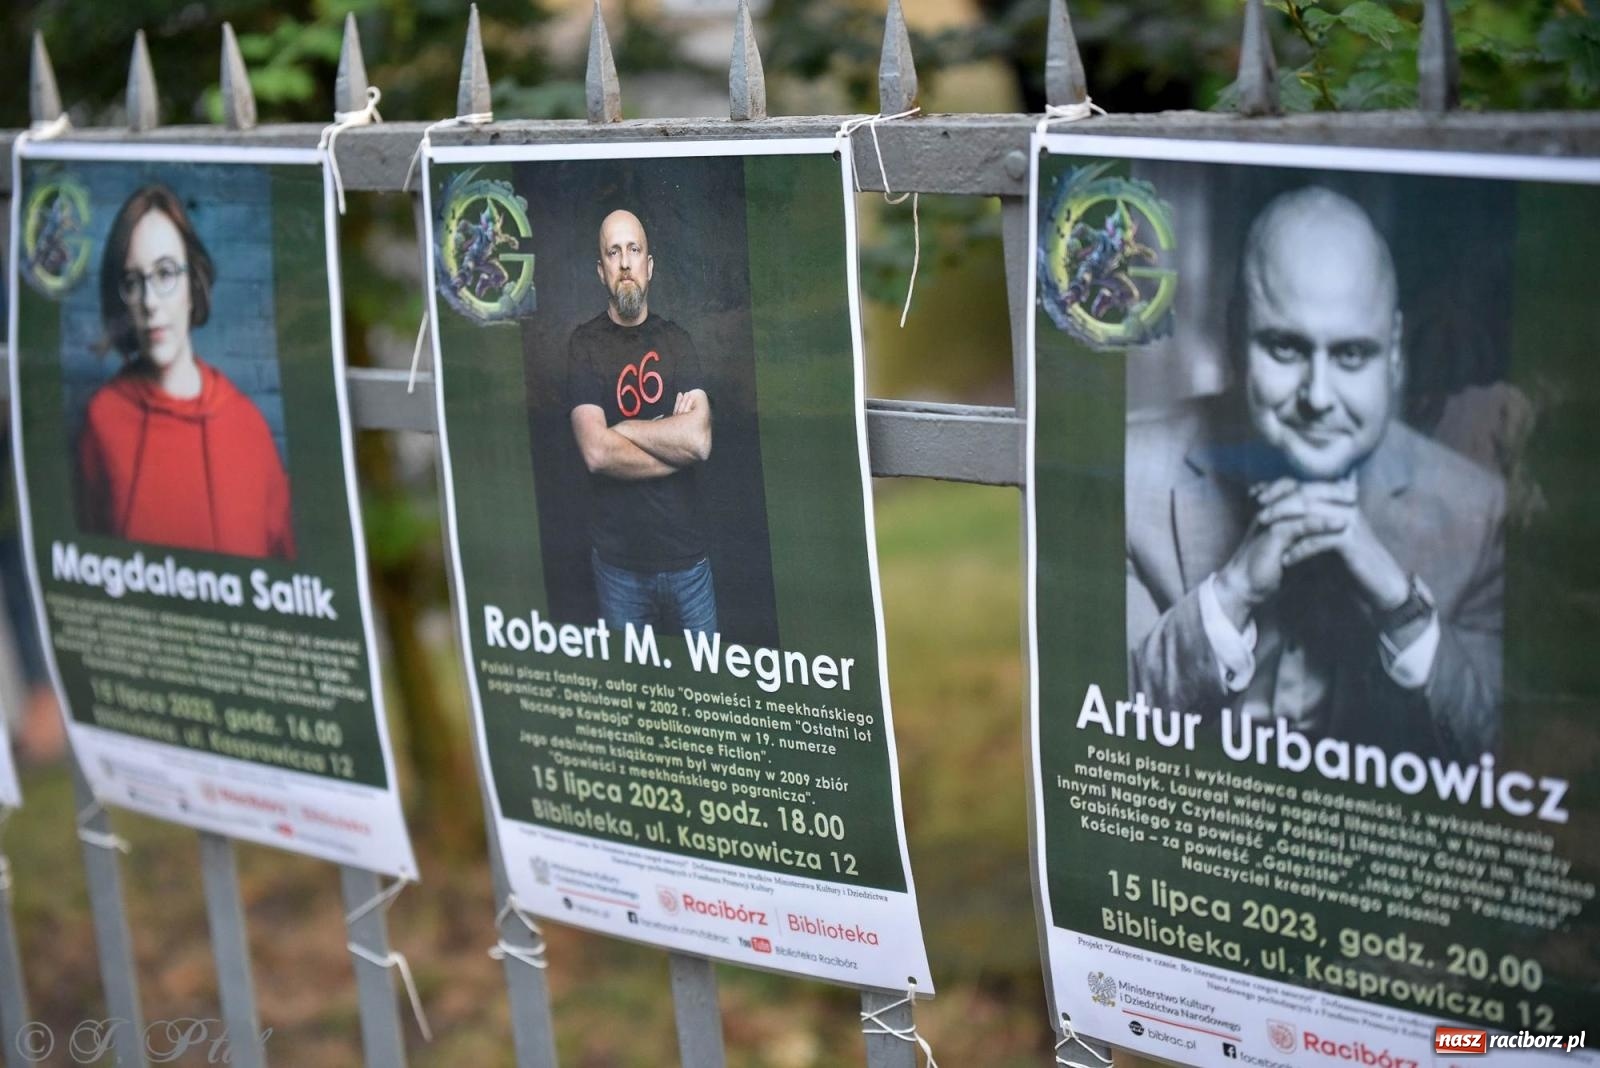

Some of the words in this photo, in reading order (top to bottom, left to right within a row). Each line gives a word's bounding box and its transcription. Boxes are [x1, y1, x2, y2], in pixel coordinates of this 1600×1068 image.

[616, 351, 663, 418] 66
[51, 540, 244, 606] Magdalena
[250, 568, 338, 620] Salik
[484, 605, 610, 660] Robert
[624, 621, 672, 669] M.
[684, 628, 854, 692] Wegner
[481, 660, 513, 675] Polski
[517, 666, 551, 682] pisarz
[605, 679, 637, 693] autor
[641, 684, 674, 698] cyklu
[679, 687, 751, 709] "Opowieści
[755, 700, 762, 709] z
[766, 700, 874, 726] meekhańskiego
[637, 701, 646, 711] w
[650, 701, 679, 716] 2002
[682, 709, 691, 717] r.
[695, 709, 792, 731] opowiadaniem
[796, 719, 850, 739] "Ostatni
[853, 728, 872, 742] lot
[520, 698, 574, 719] Nocnego
[576, 707, 632, 726] Kowboja"
[638, 717, 737, 742] opublikowanym
[741, 734, 751, 743] w
[756, 732, 774, 747] 19.
[779, 738, 837, 755] numerze
[575, 725, 654, 746] miesięcznika
[1076, 683, 1202, 750] Artur
[1221, 707, 1570, 824] Urbanowicz
[329, 754, 355, 778] 12
[520, 730, 548, 748] Jego
[550, 736, 606, 755] debiutem
[609, 744, 683, 769] książkowym
[687, 753, 707, 772] był
[711, 761, 760, 781] wydany
[765, 771, 776, 780] w
[780, 771, 810, 786] 2009
[814, 777, 849, 792] zbiór
[620, 765, 626, 774] z
[629, 765, 727, 792] meekhańskiego
[732, 783, 816, 805] pogranicza".
[1087, 745, 1131, 766] Polski
[1136, 756, 1181, 778] pisarz
[1185, 764, 1190, 778] i
[532, 765, 558, 792] 15
[562, 771, 623, 802] lipca
[628, 781, 692, 818] 2023,
[699, 799, 769, 828] godz.
[777, 806, 845, 841] 18.00
[1057, 774, 1106, 797] innymi
[1111, 786, 1177, 814] Nagrody
[1182, 801, 1278, 833] Czytelników
[1282, 820, 1346, 851] Polskiej
[1350, 832, 1430, 867] Literatury
[1433, 851, 1487, 879] Grozy
[1170, 780, 1229, 805] Laureat
[1234, 795, 1276, 815] wielu
[1281, 804, 1340, 828] nagród
[1446, 838, 1462, 852] w
[1466, 837, 1500, 859] tym
[532, 797, 640, 840] Biblioteka,
[645, 821, 671, 844] ul.
[677, 825, 823, 872] Kasprowicza
[830, 851, 859, 876] 12
[1070, 795, 1171, 830] Grabińskiego
[1175, 820, 1193, 833] za
[1197, 825, 1264, 850] powieść
[1370, 860, 1407, 881] oraz
[1081, 815, 1145, 843] Kościeja
[1162, 836, 1180, 849] za
[1184, 840, 1250, 865] powieść
[1421, 890, 1461, 911] oraz
[683, 894, 768, 926] Racibórz
[816, 884, 841, 896] Kultury
[847, 888, 889, 902] Dziedzictwa
[1181, 855, 1270, 888] Nauczyciel
[1274, 875, 1383, 914] kreatywnego
[1386, 900, 1451, 927] pisania
[775, 946, 817, 962] Biblioteka
[819, 954, 858, 969] Racibórz
[787, 913, 880, 946] Biblioteka
[1077, 936, 1103, 951] Projekt
[1108, 870, 1141, 901] 15
[1152, 879, 1231, 923] lipca
[1242, 900, 1327, 948] 2023,
[1339, 928, 1435, 969] godz.
[1446, 943, 1543, 992] 20.00
[1101, 907, 1250, 967] Biblioteka,
[1260, 948, 1295, 975] ul.
[1305, 954, 1504, 1023] Kasprowicza
[1517, 1000, 1556, 1032] 12
[1118, 980, 1178, 1005] Ministerstwo
[1179, 996, 1216, 1014] Kultury
[1124, 994, 1180, 1017] Dziedzictwa
[1180, 1009, 1242, 1033] Narodowego
